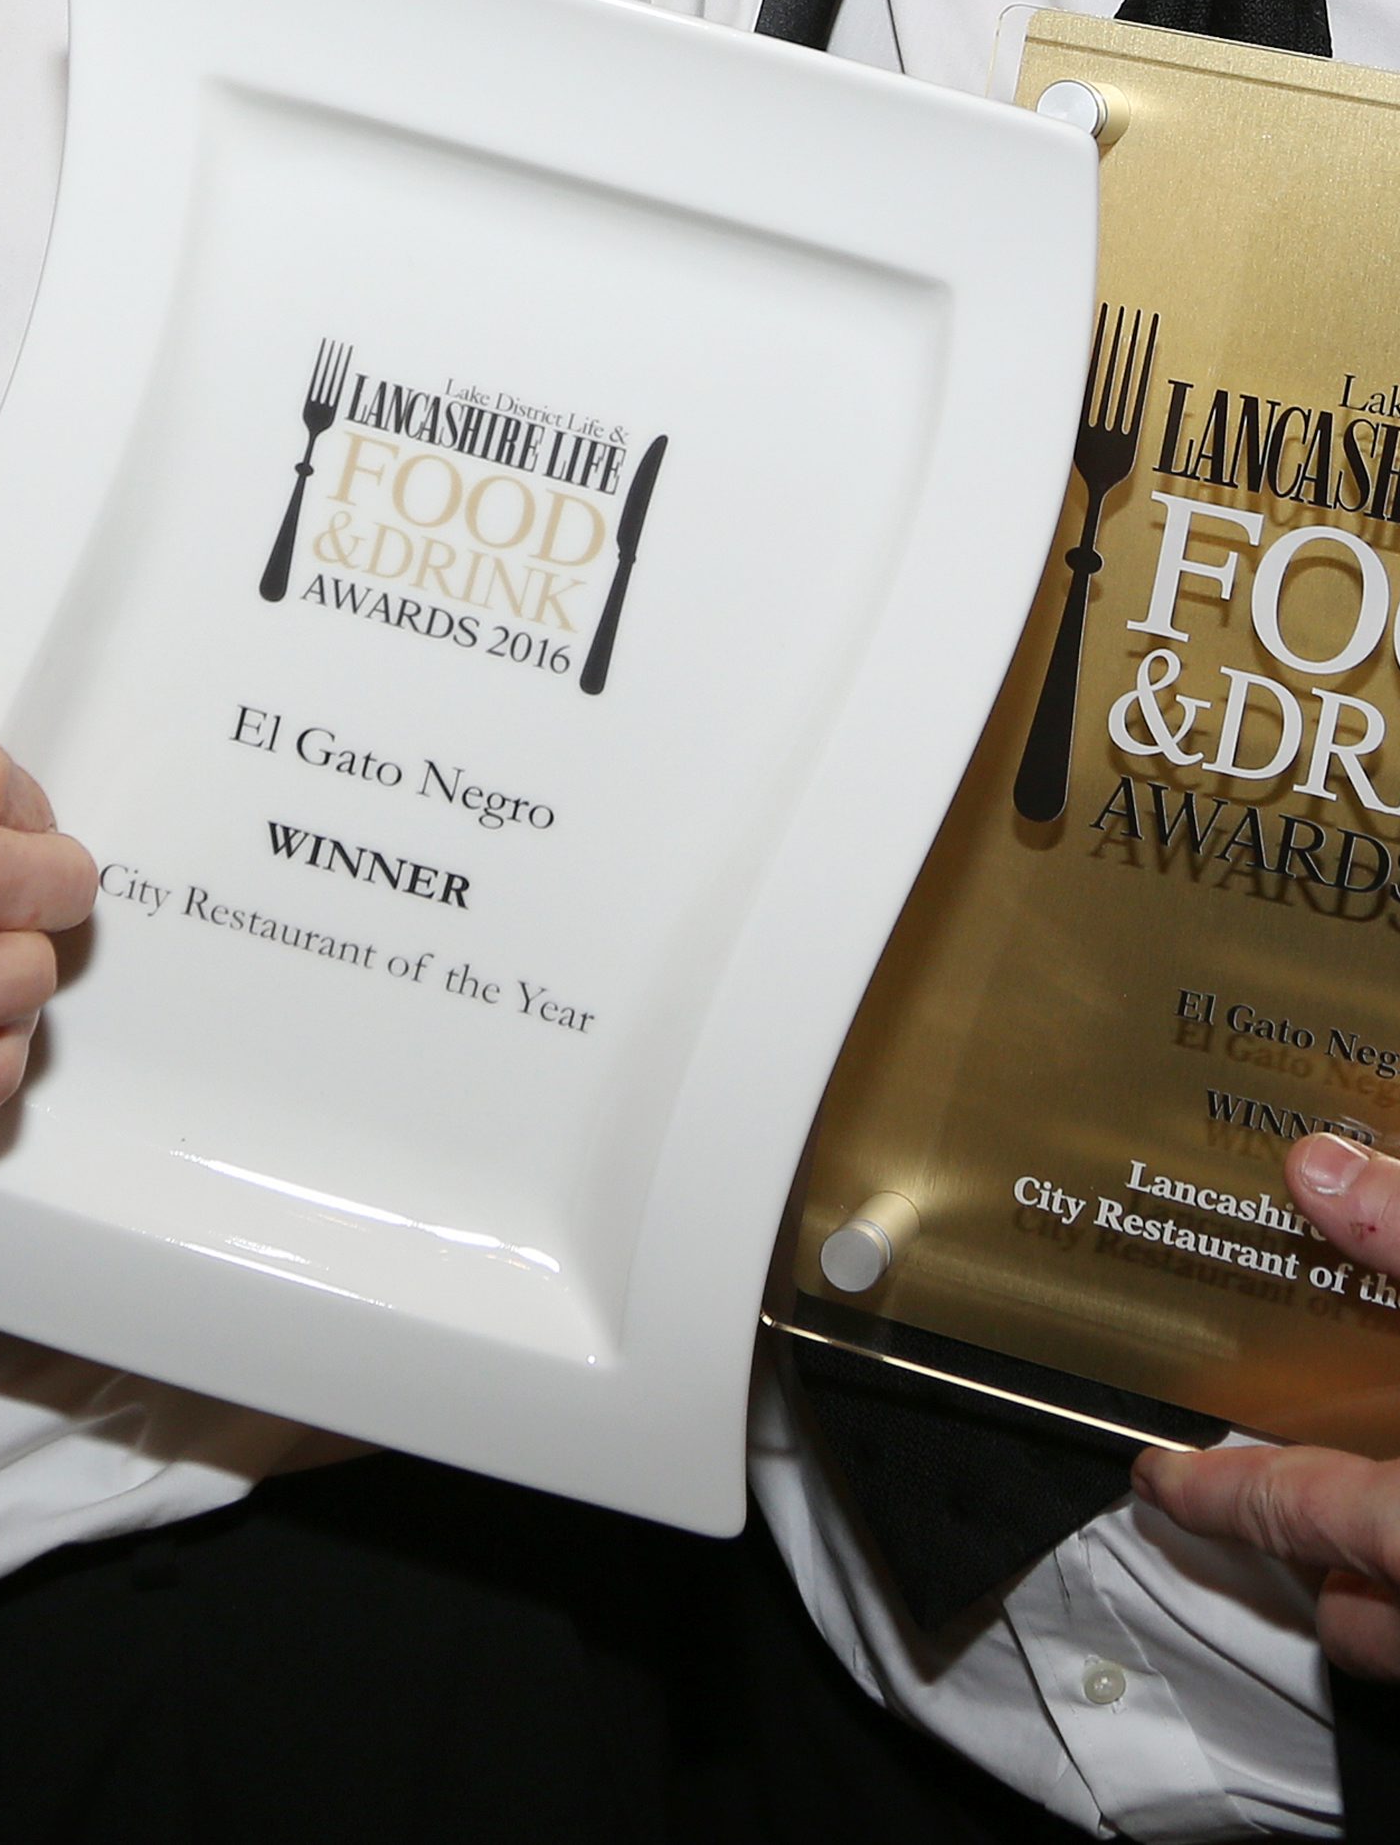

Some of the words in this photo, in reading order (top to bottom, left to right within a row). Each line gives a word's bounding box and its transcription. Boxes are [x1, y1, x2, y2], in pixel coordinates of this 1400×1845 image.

[344, 372, 546, 474] LANCASHIRE
[542, 429, 627, 496] LIFE
[443, 378, 491, 407] Lake
[494, 393, 564, 429] District
[567, 412, 605, 439] Life
[608, 425, 629, 445] &
[327, 432, 607, 567] FOOD
[300, 573, 481, 649] AWARDS
[486, 625, 571, 674] 2016
[312, 510, 586, 633] &DRINK
[228, 704, 281, 753] El
[296, 725, 403, 788] Gato
[415, 759, 556, 831] Negro
[267, 820, 471, 910] WINNER
[99, 862, 172, 917] City
[180, 884, 378, 970] Restaurant
[388, 953, 435, 984] of
[445, 964, 501, 1005] the
[516, 979, 597, 1035] Year
[1173, 988, 1216, 1027] El
[1226, 1002, 1316, 1050] Gato
[1012, 1175, 1086, 1226] City
[1093, 1196, 1301, 1281] Restaurant
[1308, 1263, 1354, 1296] of
